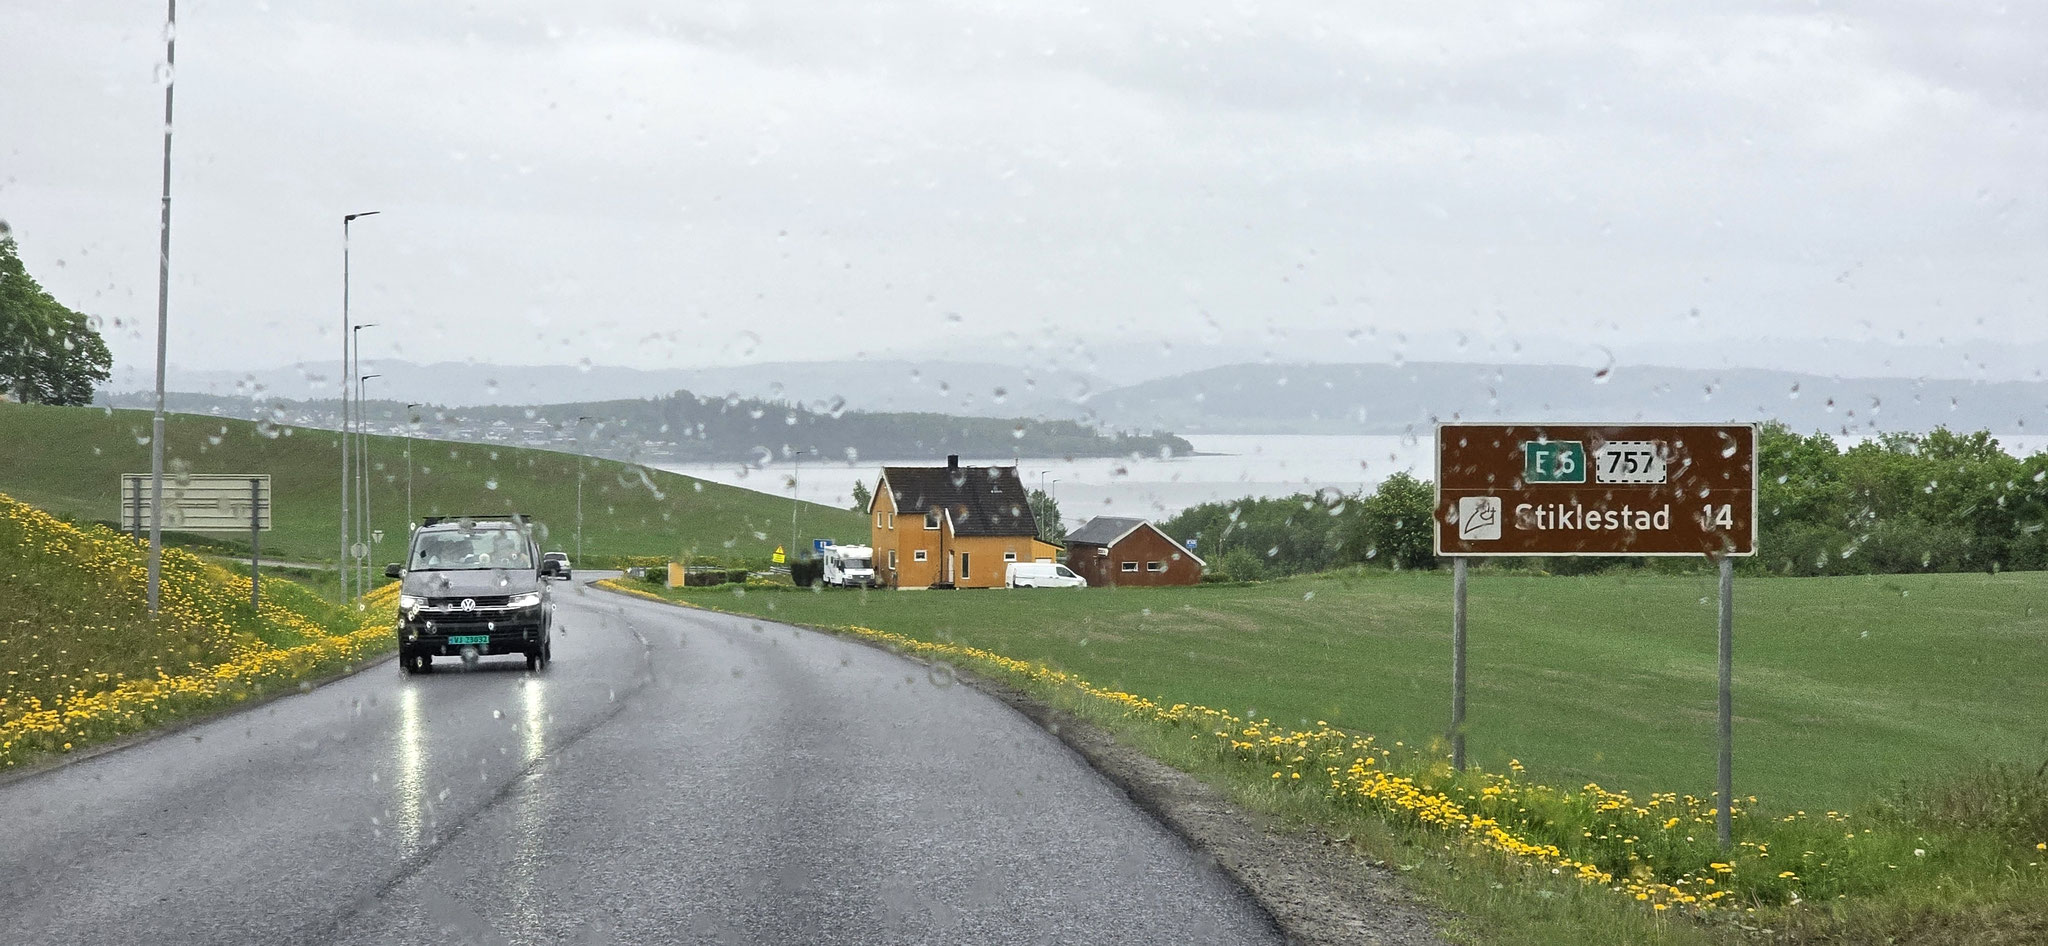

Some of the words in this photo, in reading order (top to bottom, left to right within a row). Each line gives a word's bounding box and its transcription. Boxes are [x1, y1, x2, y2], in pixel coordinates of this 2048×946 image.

[1606, 450, 1655, 474] 757
[1514, 504, 1670, 530] Stiklestad
[1702, 504, 1734, 530] 14
